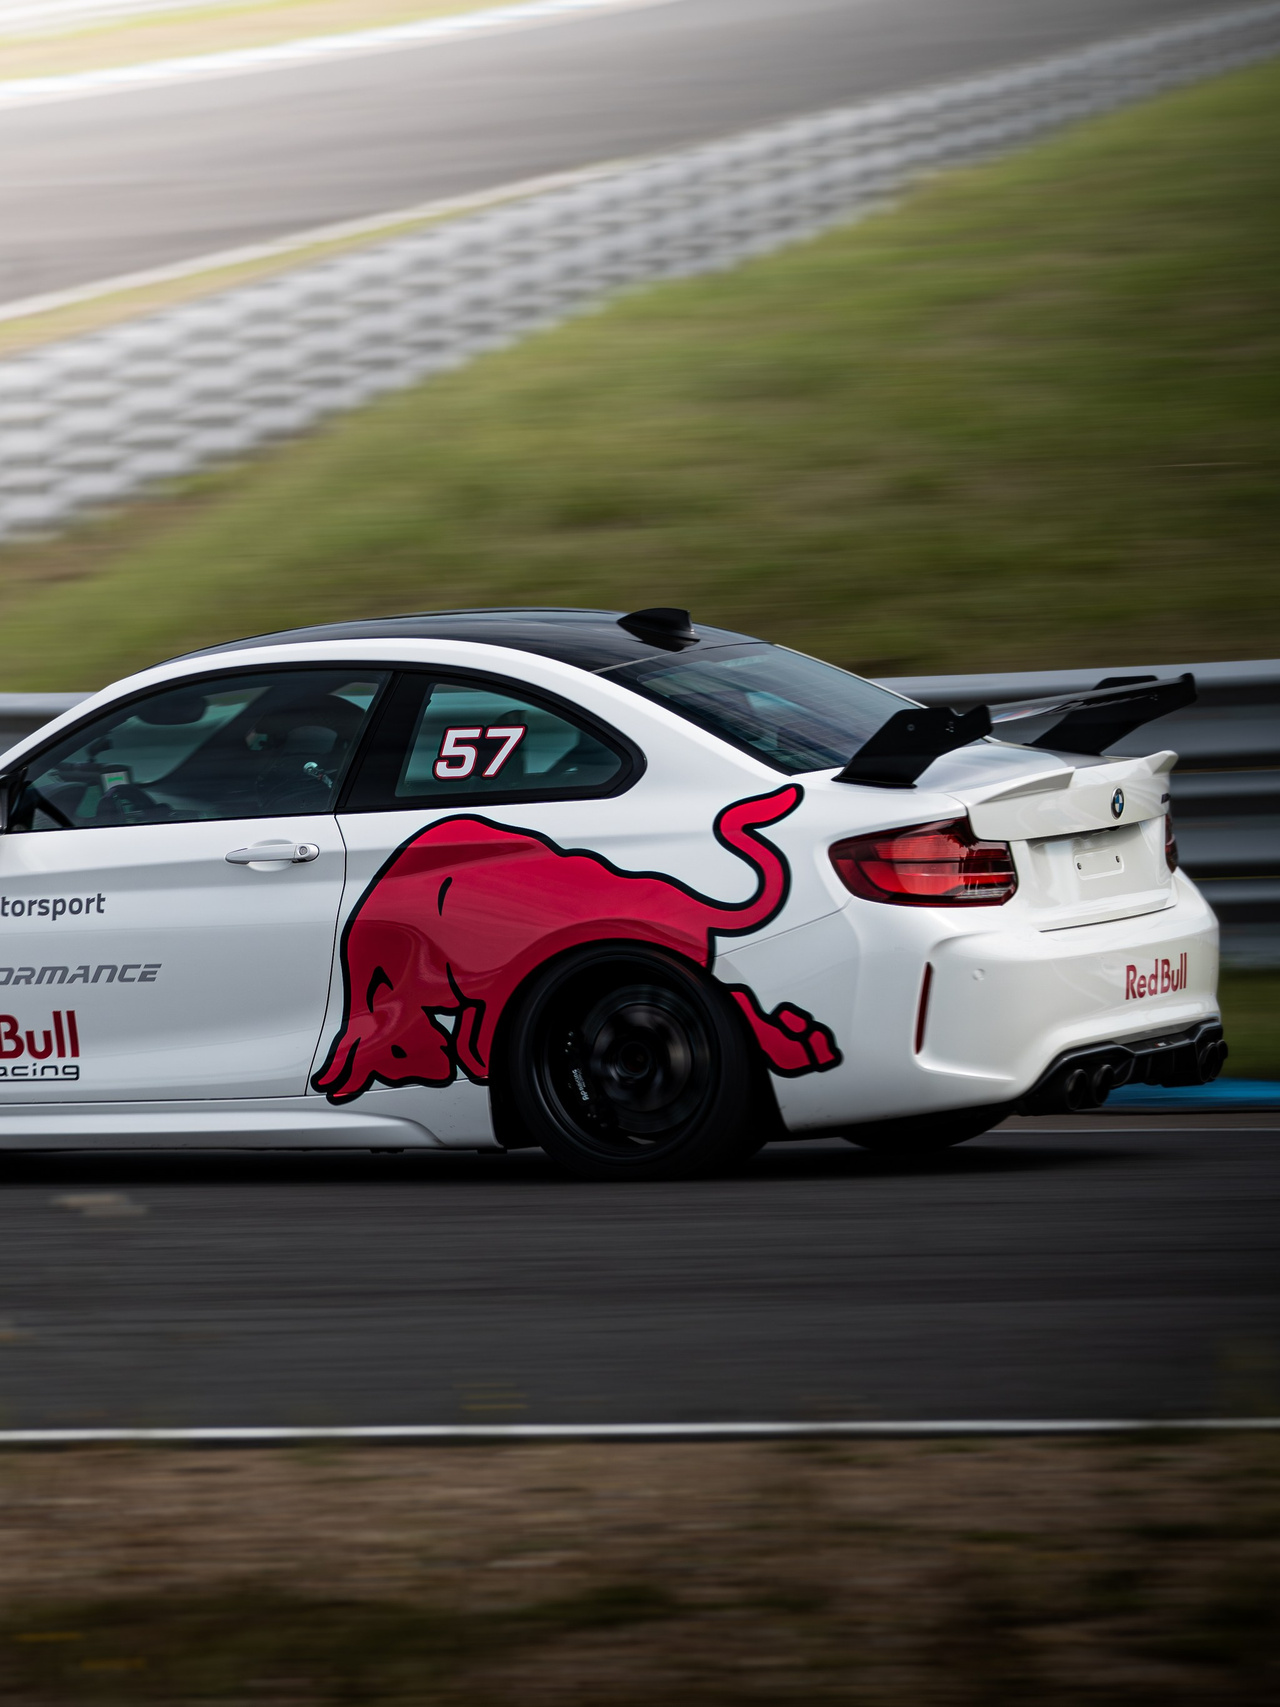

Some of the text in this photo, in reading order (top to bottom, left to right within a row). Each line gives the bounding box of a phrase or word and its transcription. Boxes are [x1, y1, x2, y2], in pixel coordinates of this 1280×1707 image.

[434, 725, 526, 780] 57
[1125, 952, 1187, 1000] Red Bull
